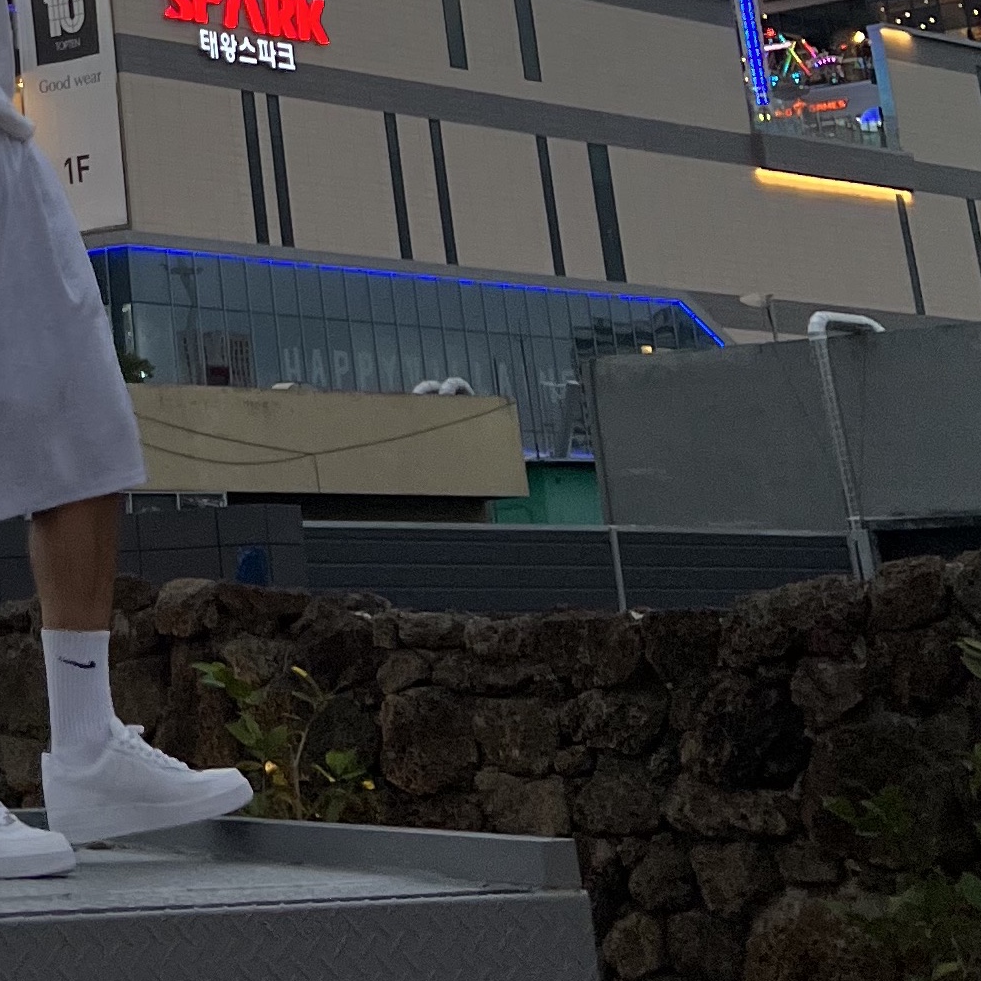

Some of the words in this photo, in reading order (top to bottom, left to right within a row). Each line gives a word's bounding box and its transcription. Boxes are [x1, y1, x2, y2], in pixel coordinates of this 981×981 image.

[199, 28, 296, 71] 태왕스파크
[39, 74, 71, 93] Good
[74, 71, 102, 86] wear
[63, 153, 90, 184] 1F
[283, 346, 398, 393] HAPPY
